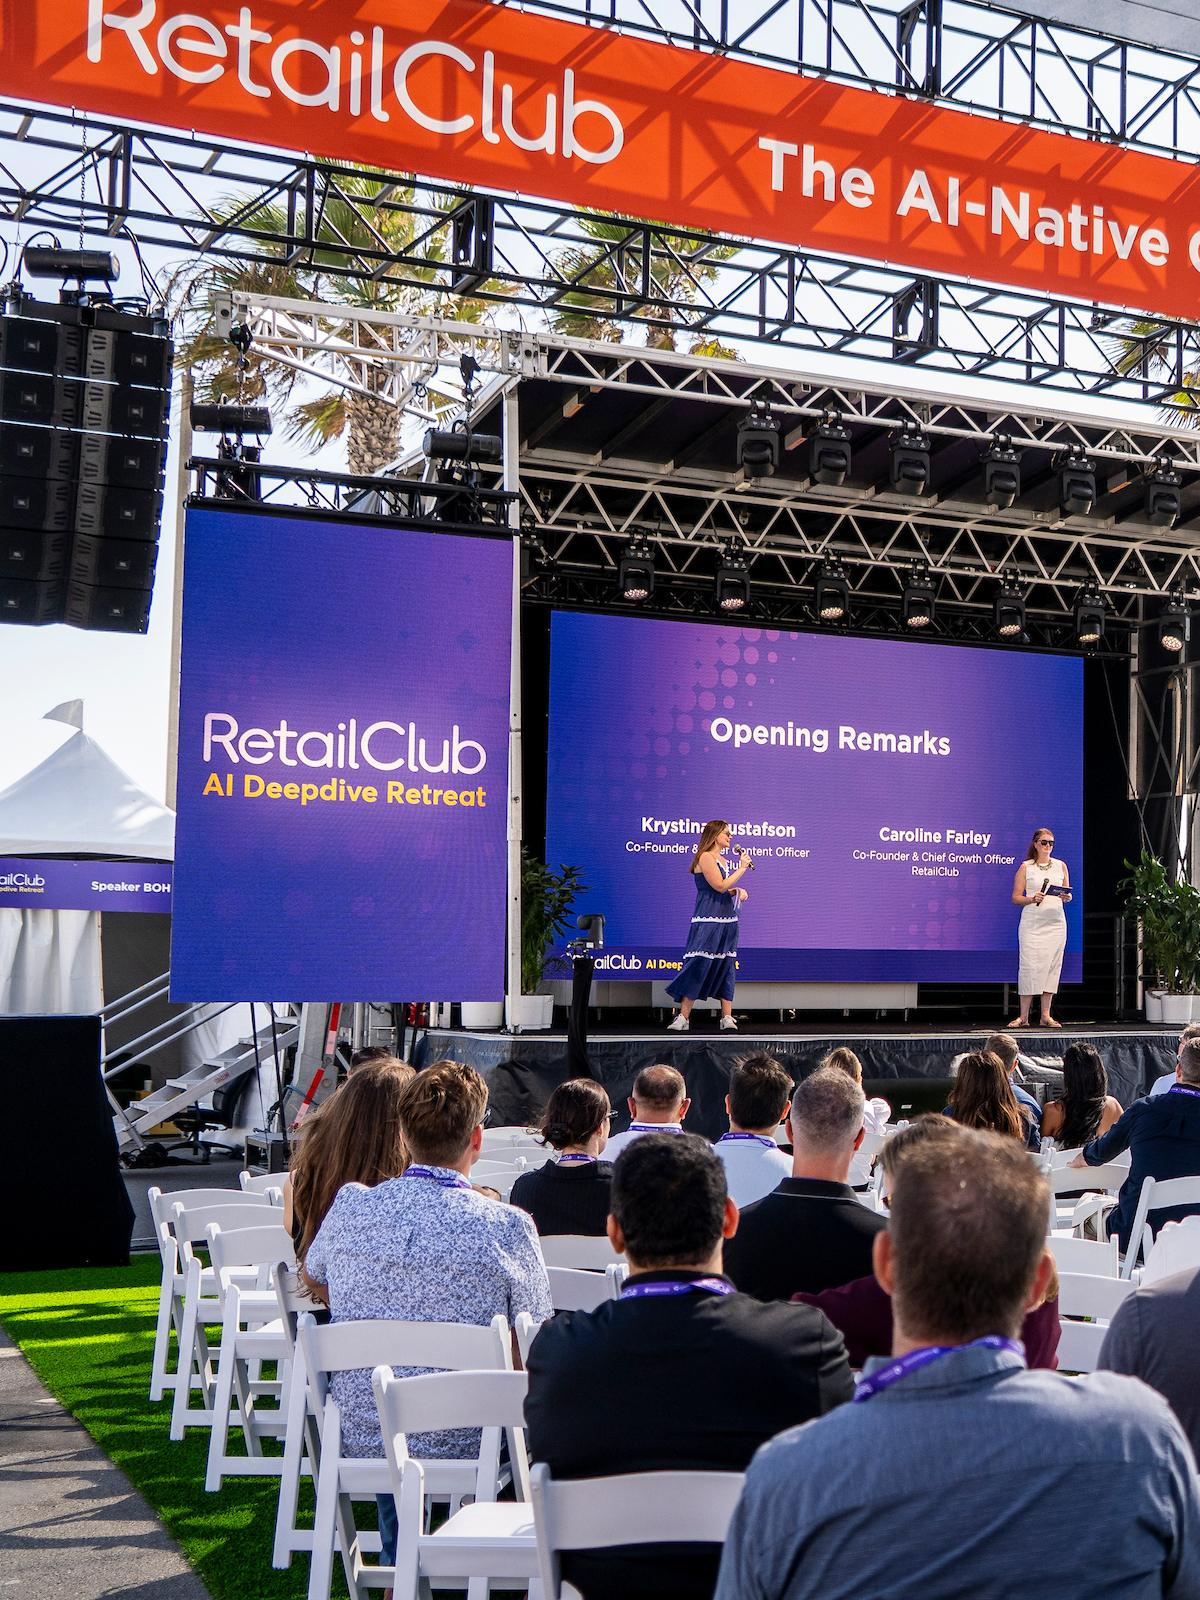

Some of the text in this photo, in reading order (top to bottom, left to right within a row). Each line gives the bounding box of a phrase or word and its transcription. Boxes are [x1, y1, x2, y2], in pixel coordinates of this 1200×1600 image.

[86, 0, 625, 165] RetailClub
[758, 136, 875, 208] The
[896, 168, 1170, 267] AI-Native
[203, 712, 487, 775] RetailClub
[710, 717, 951, 756] Opening Remarks
[203, 772, 487, 807] AI Deepdive Retreat
[729, 821, 796, 838] ustafson
[879, 827, 991, 847] Caroline Farley
[625, 841, 689, 854] Co-Founder
[691, 843, 699, 854] &
[775, 847, 810, 858] Officer
[852, 849, 1015, 866] Co-Founder & Chief Growth Officer
[0, 873, 46, 887] ailClub
[911, 866, 959, 877] RetailClub
[91, 881, 171, 893] Speaker BOH
[594, 954, 683, 972] ailClub AI Deep
